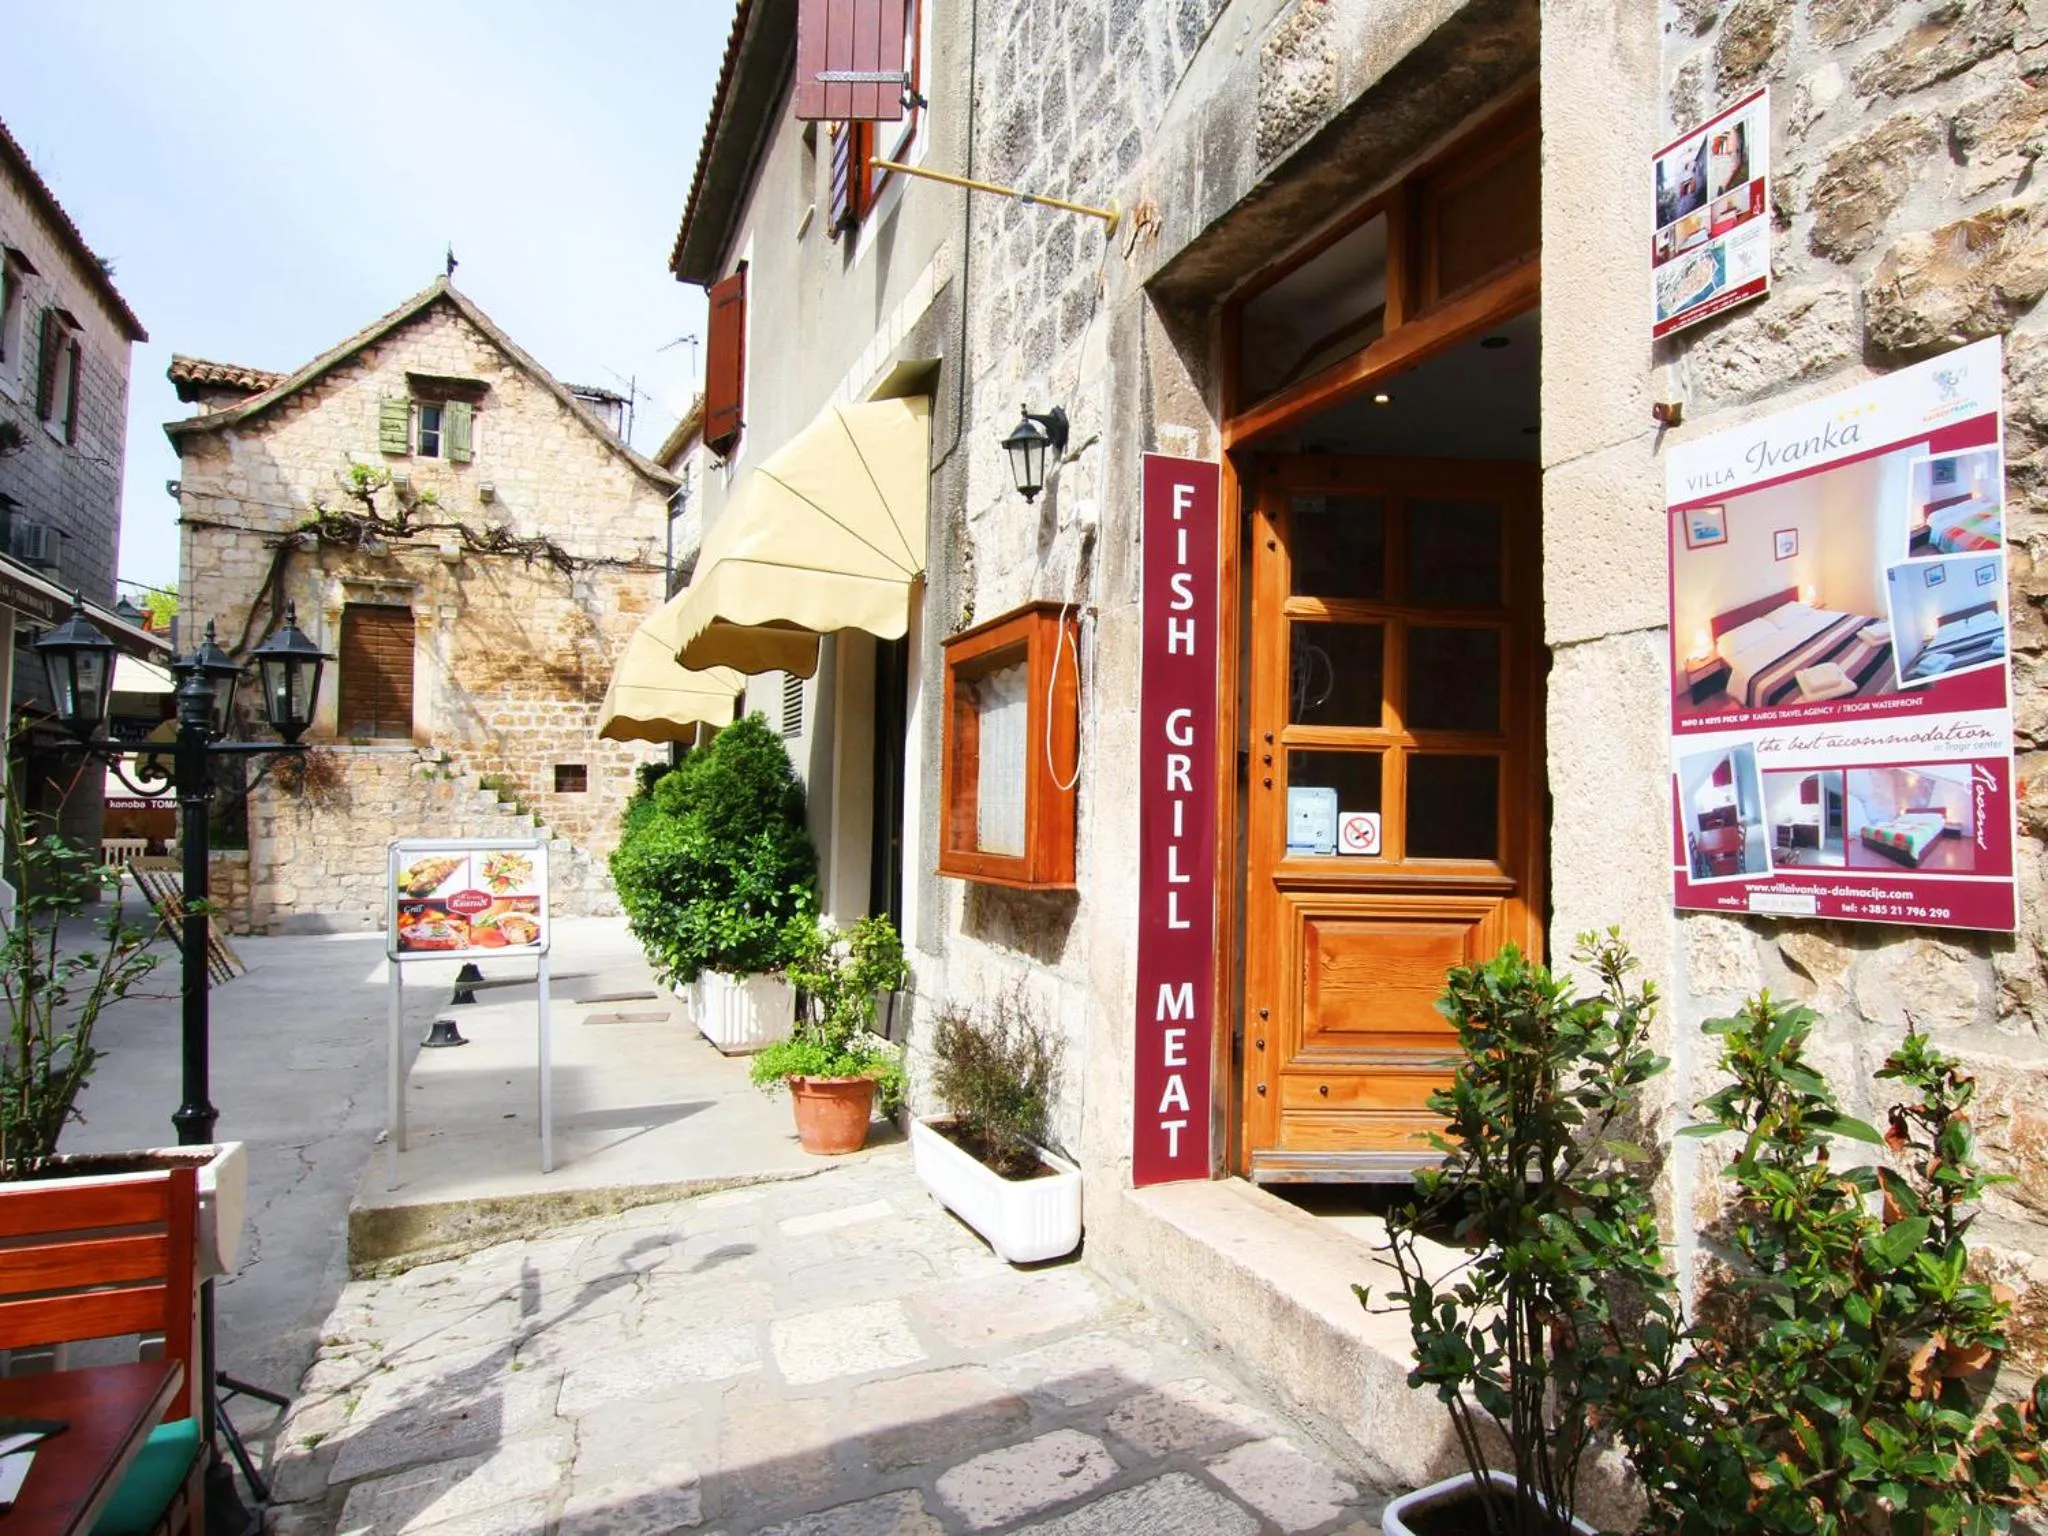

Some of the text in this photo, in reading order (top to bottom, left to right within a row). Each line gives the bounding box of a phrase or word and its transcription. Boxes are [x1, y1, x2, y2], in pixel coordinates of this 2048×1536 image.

[1687, 420, 1861, 492] VILLA Ivanka
[1723, 715, 1738, 724] PICK
[1739, 714, 1750, 722] UP
[1753, 713, 1777, 721] KAIROS
[1778, 709, 1802, 718] TRAVEL
[1803, 706, 1834, 717] AGENCY
[1843, 702, 1871, 713] TROGIR
[1871, 697, 1924, 710] WATERFRONT
[1756, 721, 1995, 754] the best accommodation
[1945, 741, 1971, 753] Trogir
[1972, 739, 2003, 751] center
[1155, 484, 1195, 1158] FISH GRILL MEAT
[1744, 882, 1914, 900] www.villaivanka-dalmacija.com
[1842, 903, 1950, 919] tel: +385 21 796 290
